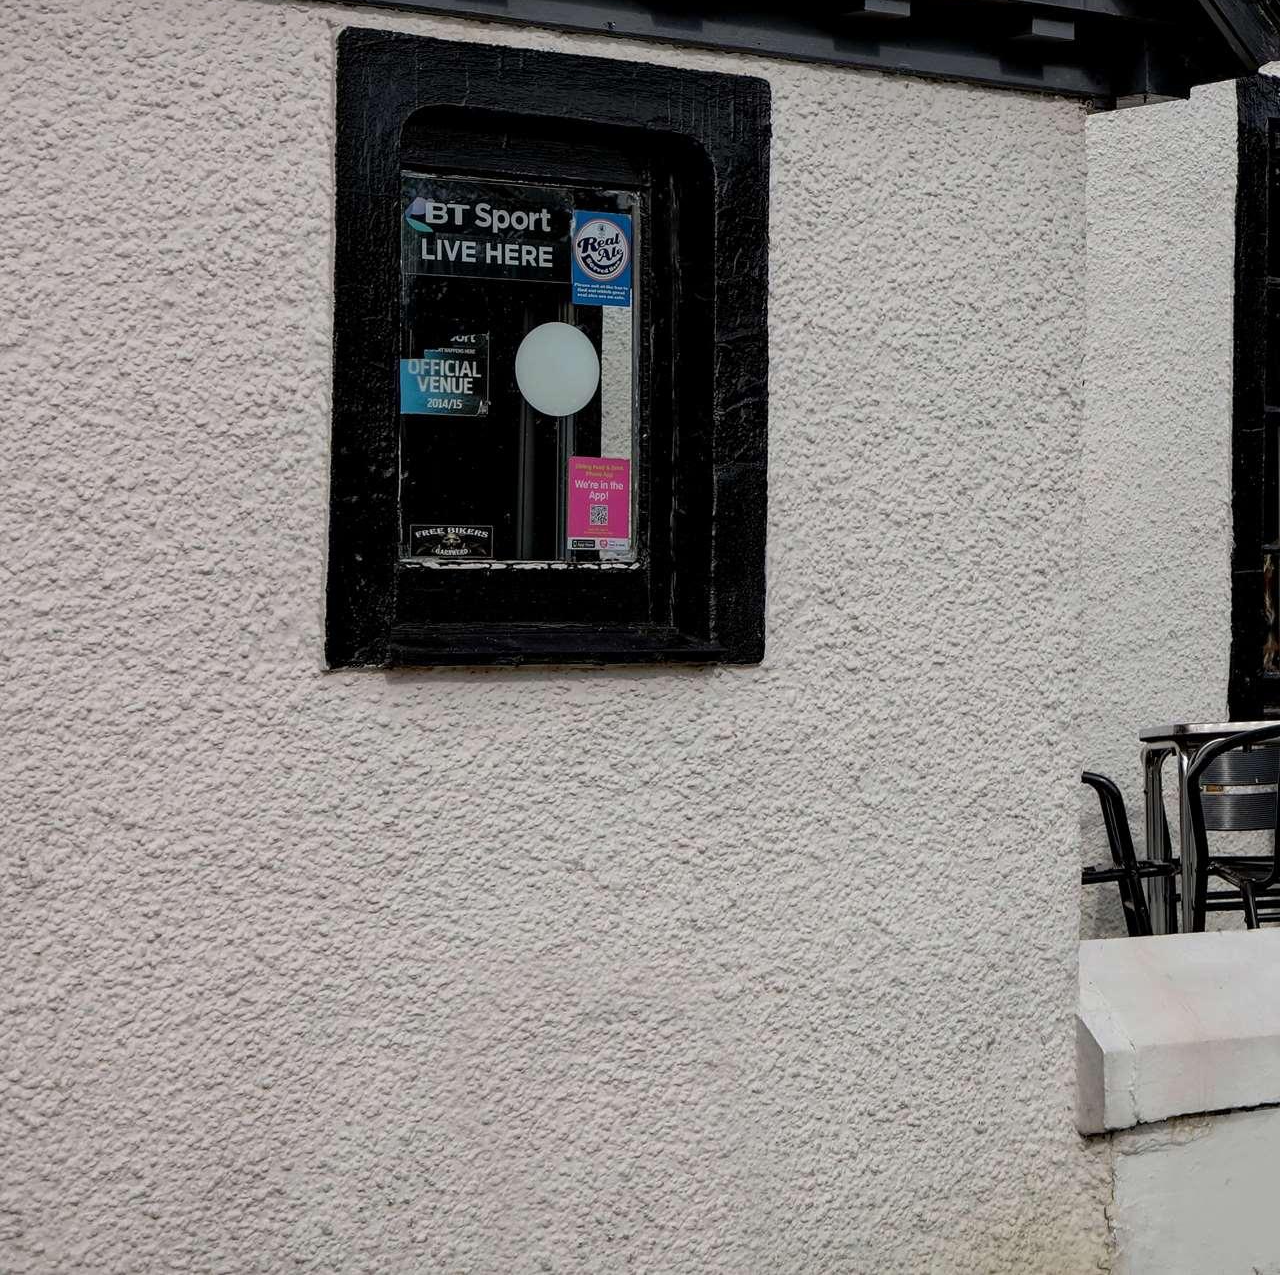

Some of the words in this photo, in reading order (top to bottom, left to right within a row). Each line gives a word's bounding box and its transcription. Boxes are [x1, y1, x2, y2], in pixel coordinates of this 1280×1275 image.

[425, 202, 471, 225] BT
[474, 203, 552, 233] Sport
[578, 233, 620, 254] Real
[421, 237, 477, 263] LIVE
[486, 242, 554, 268] HERE
[597, 247, 622, 262] Ale
[408, 359, 482, 378] OFFICIAL
[417, 376, 473, 395] VENUE
[427, 398, 463, 409] 2014/15
[575, 479, 598, 489] We're
[600, 480, 608, 489] in
[610, 481, 624, 490] the
[589, 490, 609, 501] App!
[415, 528, 446, 538] FREE
[447, 527, 489, 538] BIKERS
